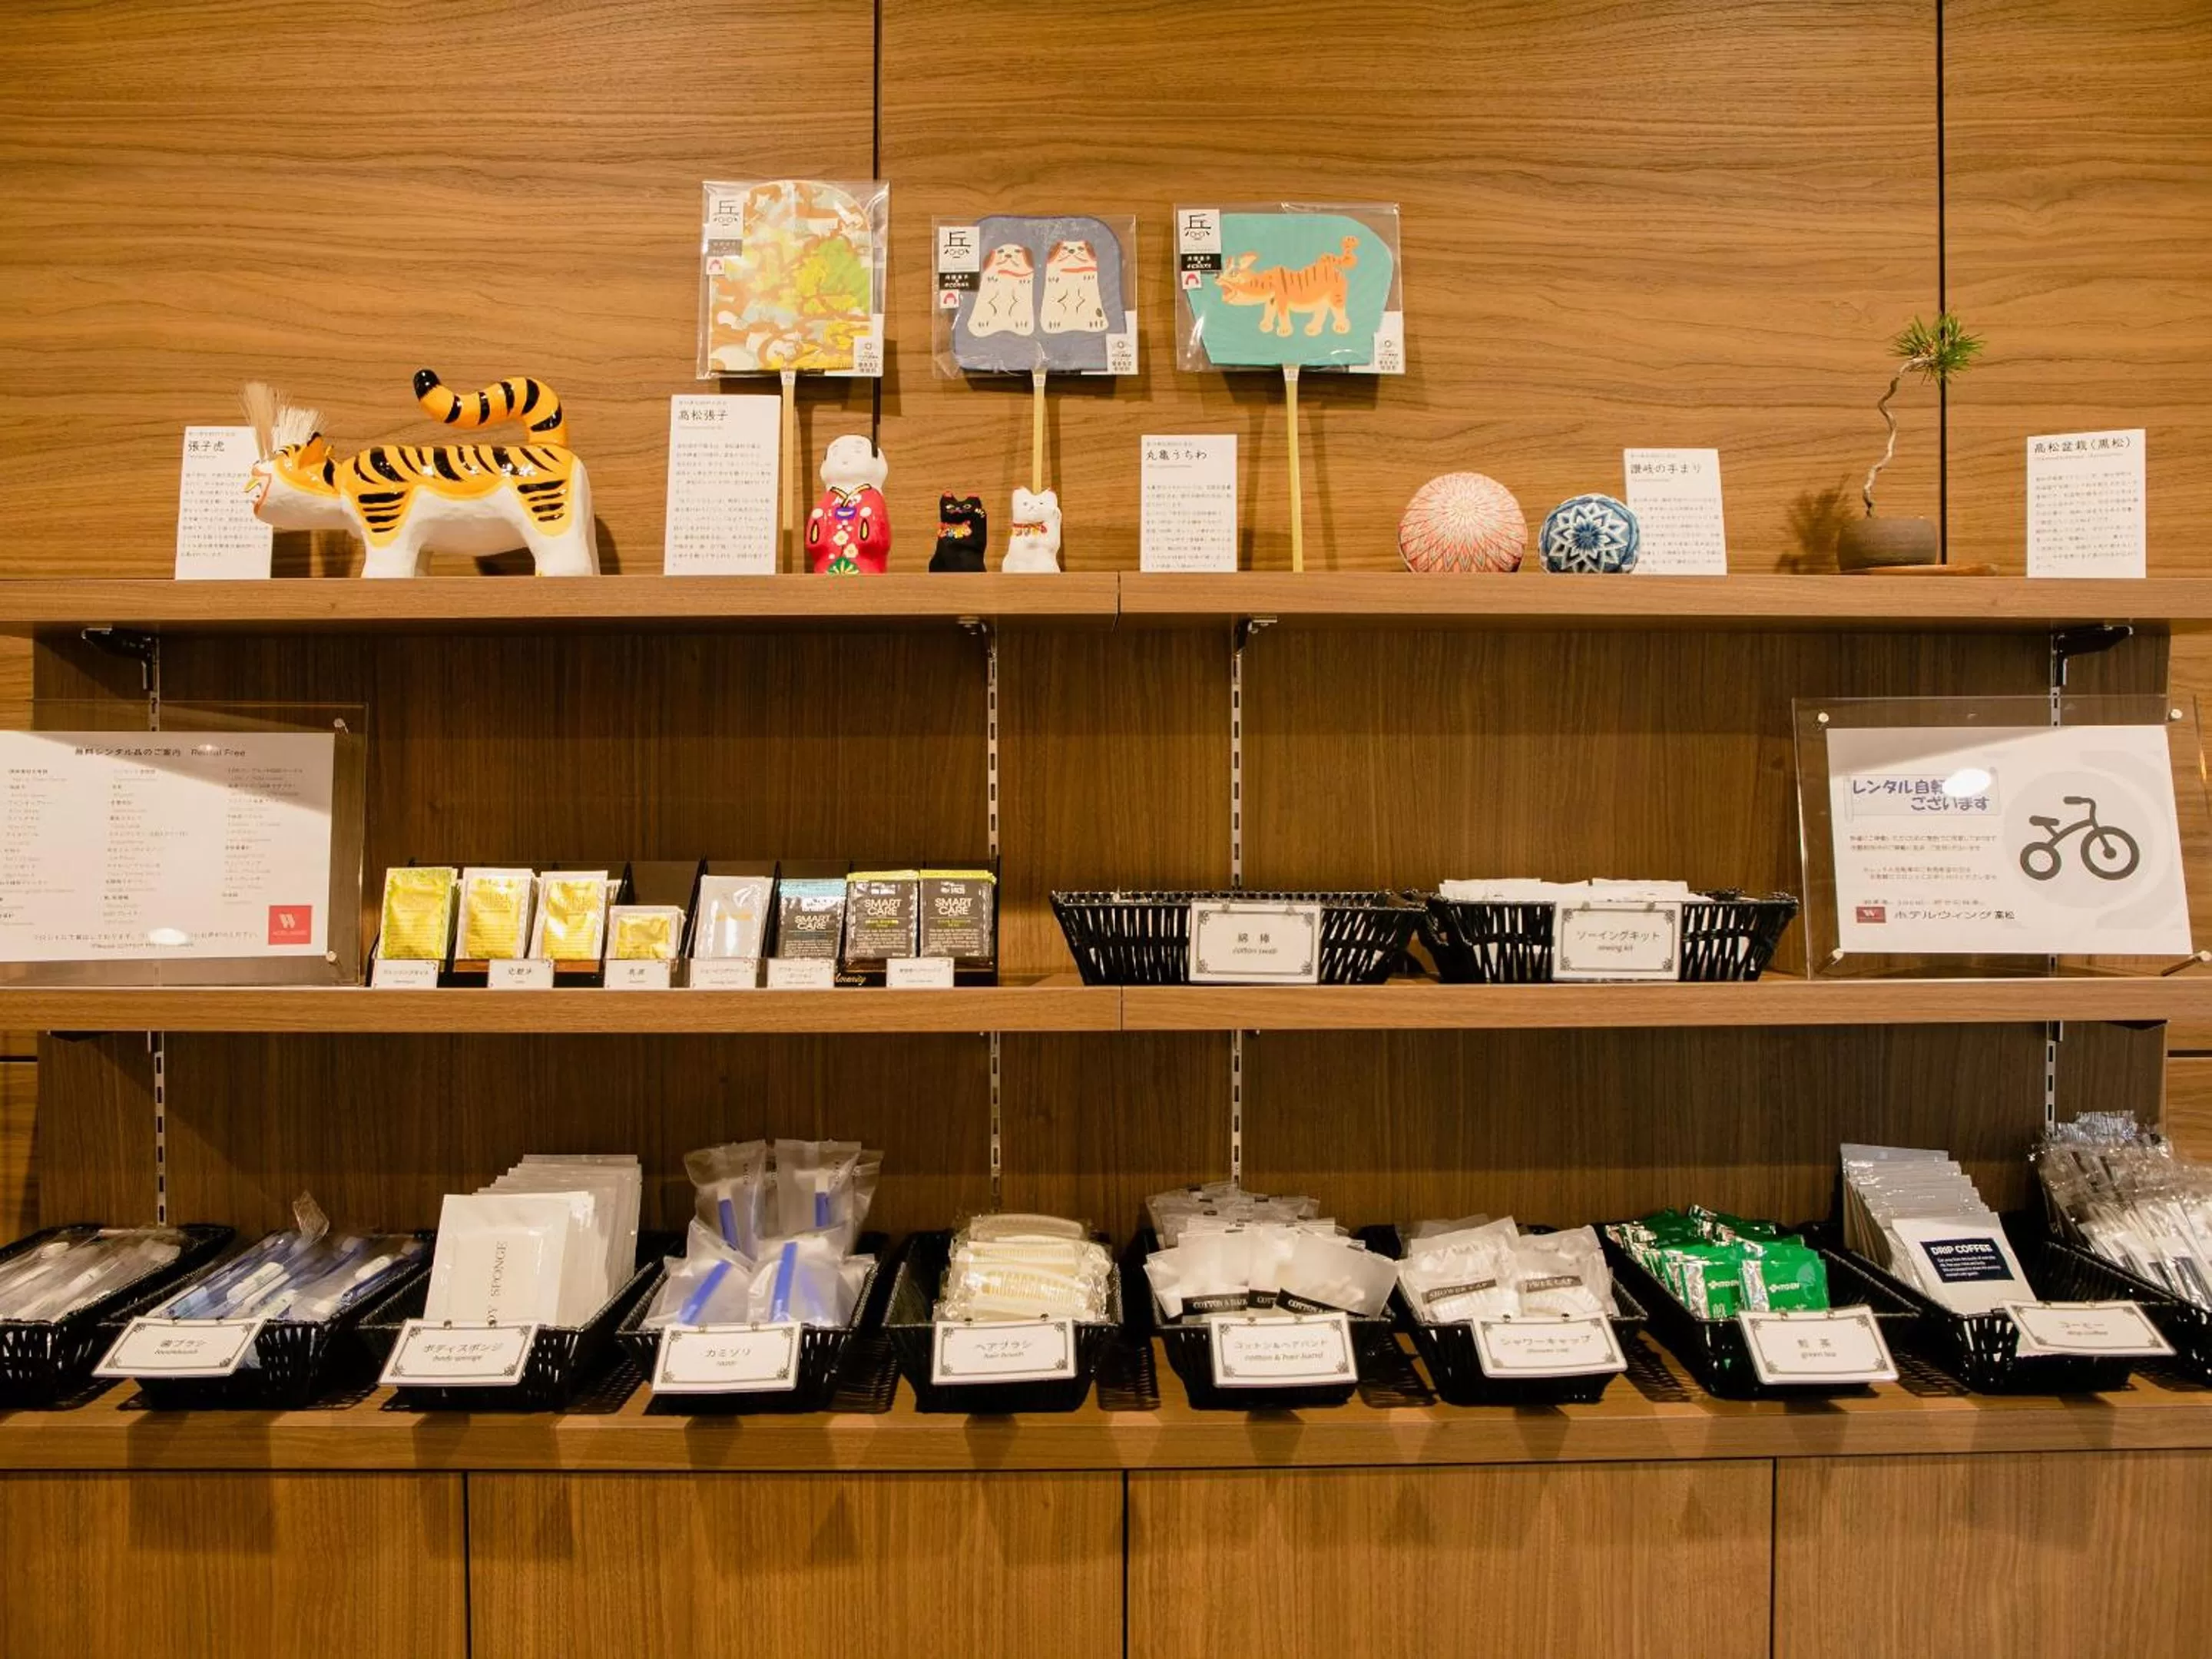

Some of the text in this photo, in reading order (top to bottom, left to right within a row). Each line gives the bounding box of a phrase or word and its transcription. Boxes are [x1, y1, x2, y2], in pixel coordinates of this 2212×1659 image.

[188, 440, 224, 452] 張子虎
[1146, 449, 1207, 461] 丸亀うちわ
[224, 748, 246, 757] Free
[1853, 780, 1946, 795] レンタル自転
[1911, 796, 1990, 810] ございます
[864, 899, 902, 908] SMART
[934, 897, 973, 907] SMART
[866, 907, 898, 916] CARE
[938, 906, 969, 917] CARE
[1894, 910, 2016, 919] ホテルウィング高松
[794, 915, 830, 923] SMART
[797, 922, 827, 931] CARE
[1578, 931, 1661, 941] ソーイングキット
[1929, 1243, 1993, 1256] DRIP COFFEE
[491, 1240, 508, 1296] SPONGE
[1428, 1286, 1467, 1299] SHOWER
[1257, 1296, 1277, 1306] COTT
[2059, 1321, 2105, 1330] コーヒー
[1500, 1336, 1591, 1346] シャワーキャップ
[423, 1343, 504, 1353] ボディスポンジ
[705, 1348, 751, 1358] カミソリ
